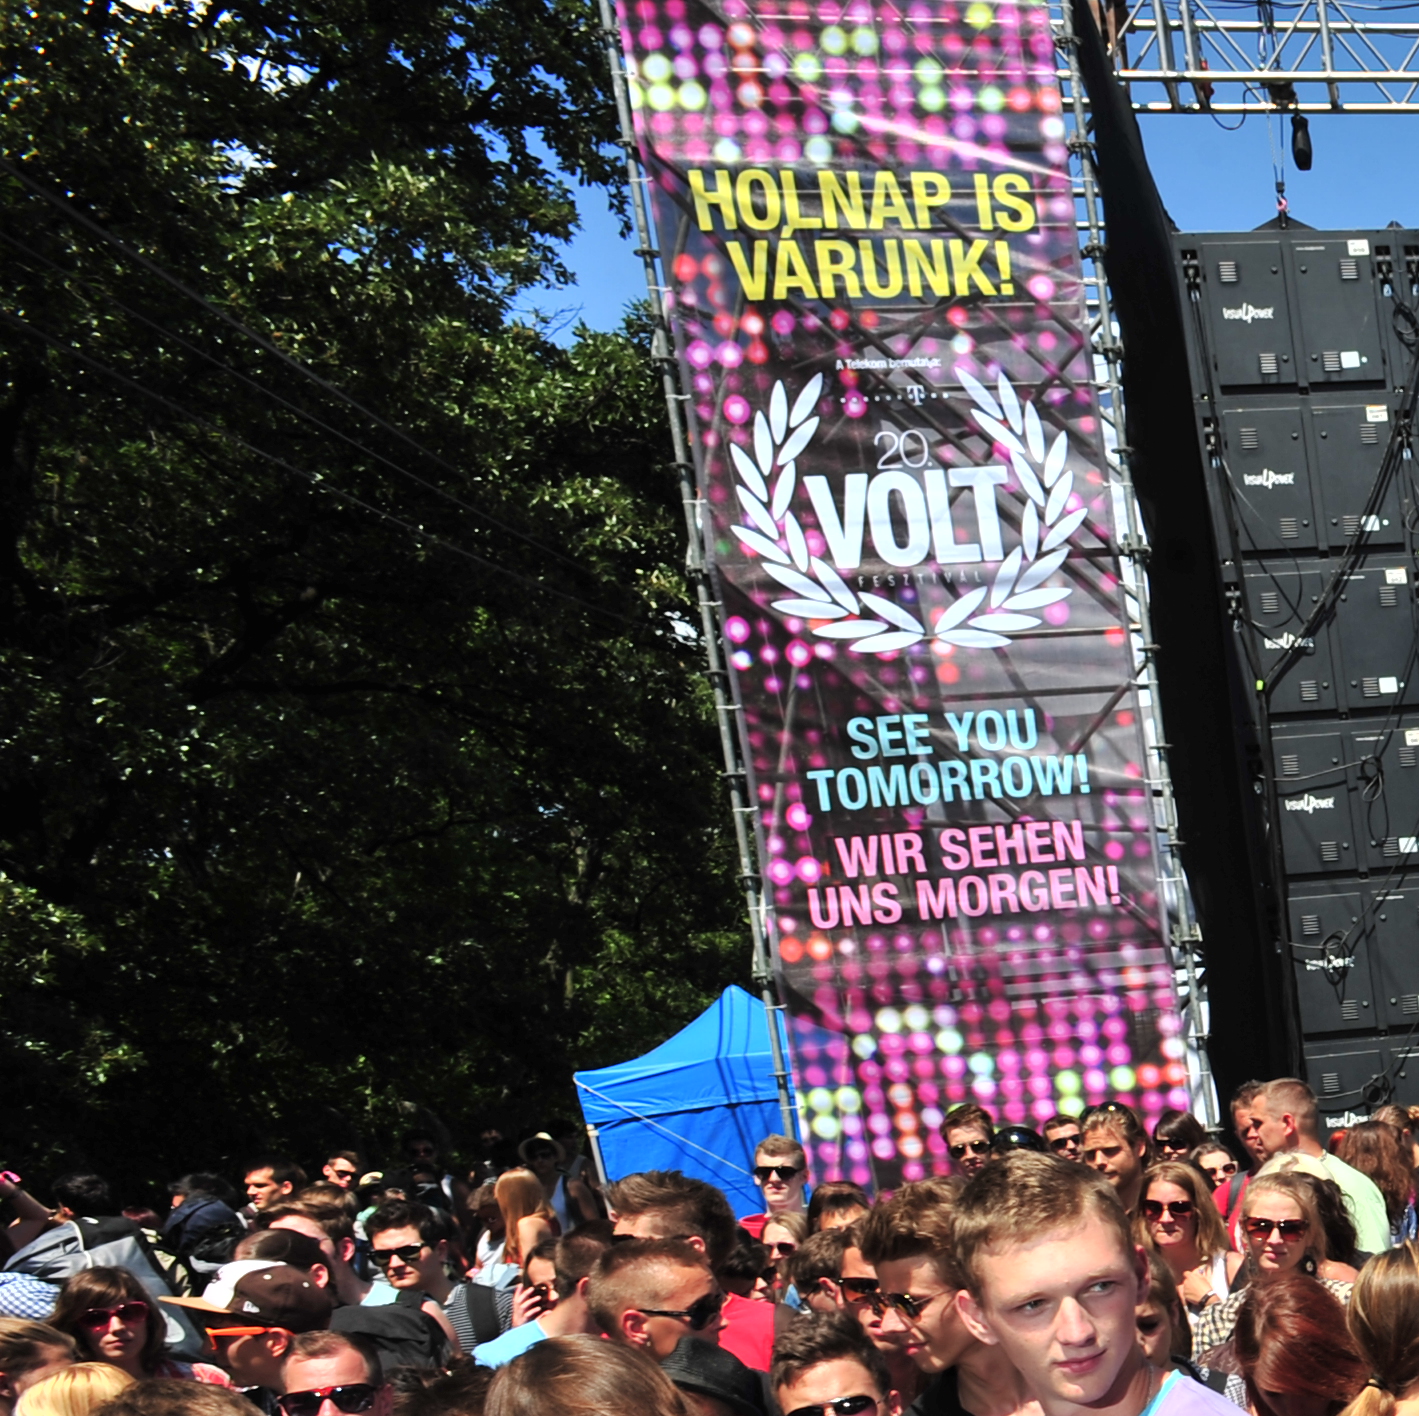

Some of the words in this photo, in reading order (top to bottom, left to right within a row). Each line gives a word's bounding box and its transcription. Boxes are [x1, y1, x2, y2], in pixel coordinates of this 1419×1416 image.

[687, 168, 951, 231] HOLNAP
[974, 172, 1036, 233] IS
[726, 225, 1016, 301] VÁRUNK!
[874, 429, 933, 471] 20.
[803, 464, 1009, 570] VOLT
[847, 714, 931, 760] SEE
[944, 708, 1039, 753] YOU
[807, 755, 1090, 812] TOMORROW!
[835, 831, 924, 878] WIR
[942, 820, 1086, 872] SEHEN
[808, 881, 902, 930] UNS
[919, 865, 1121, 922] MORGEN!
